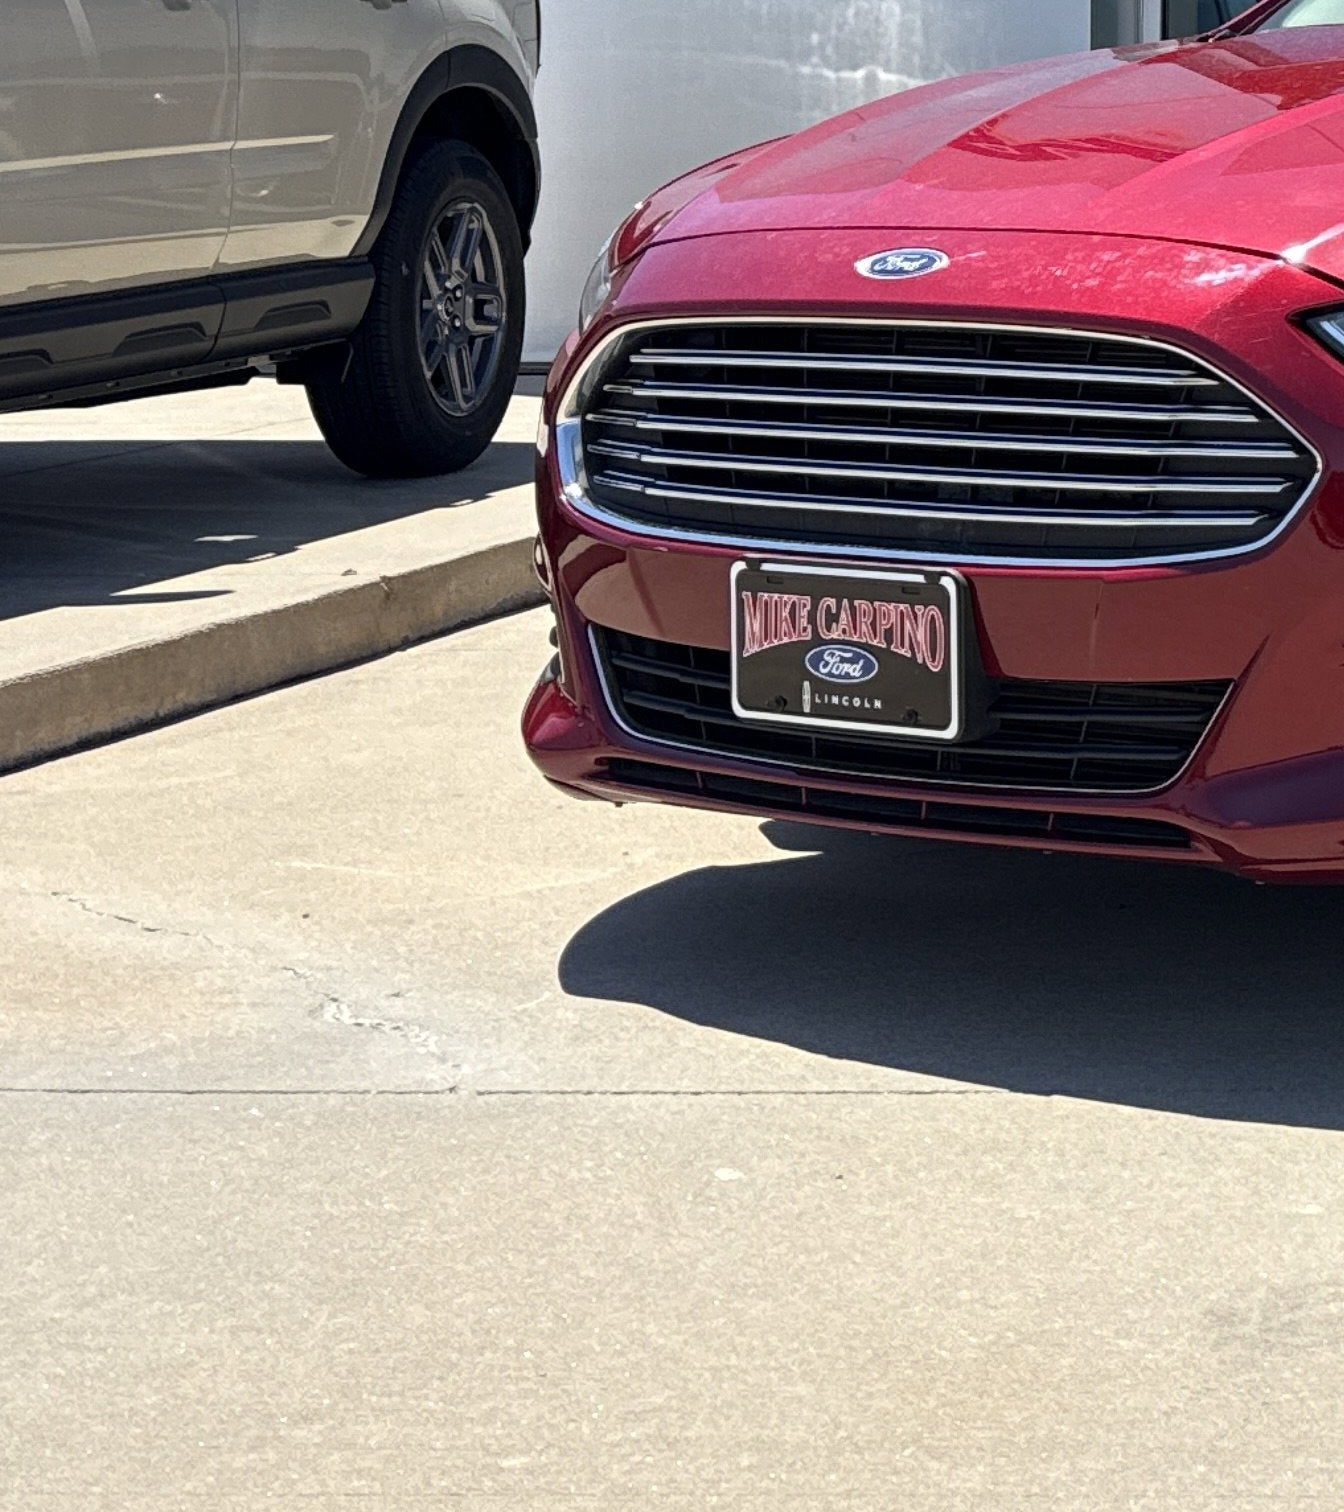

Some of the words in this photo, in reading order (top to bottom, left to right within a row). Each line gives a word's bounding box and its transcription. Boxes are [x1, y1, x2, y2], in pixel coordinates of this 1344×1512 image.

[741, 591, 812, 657] MIKE
[816, 596, 945, 672] CARPINO
[818, 651, 864, 678] Ford
[814, 693, 882, 710] LINCOLN
